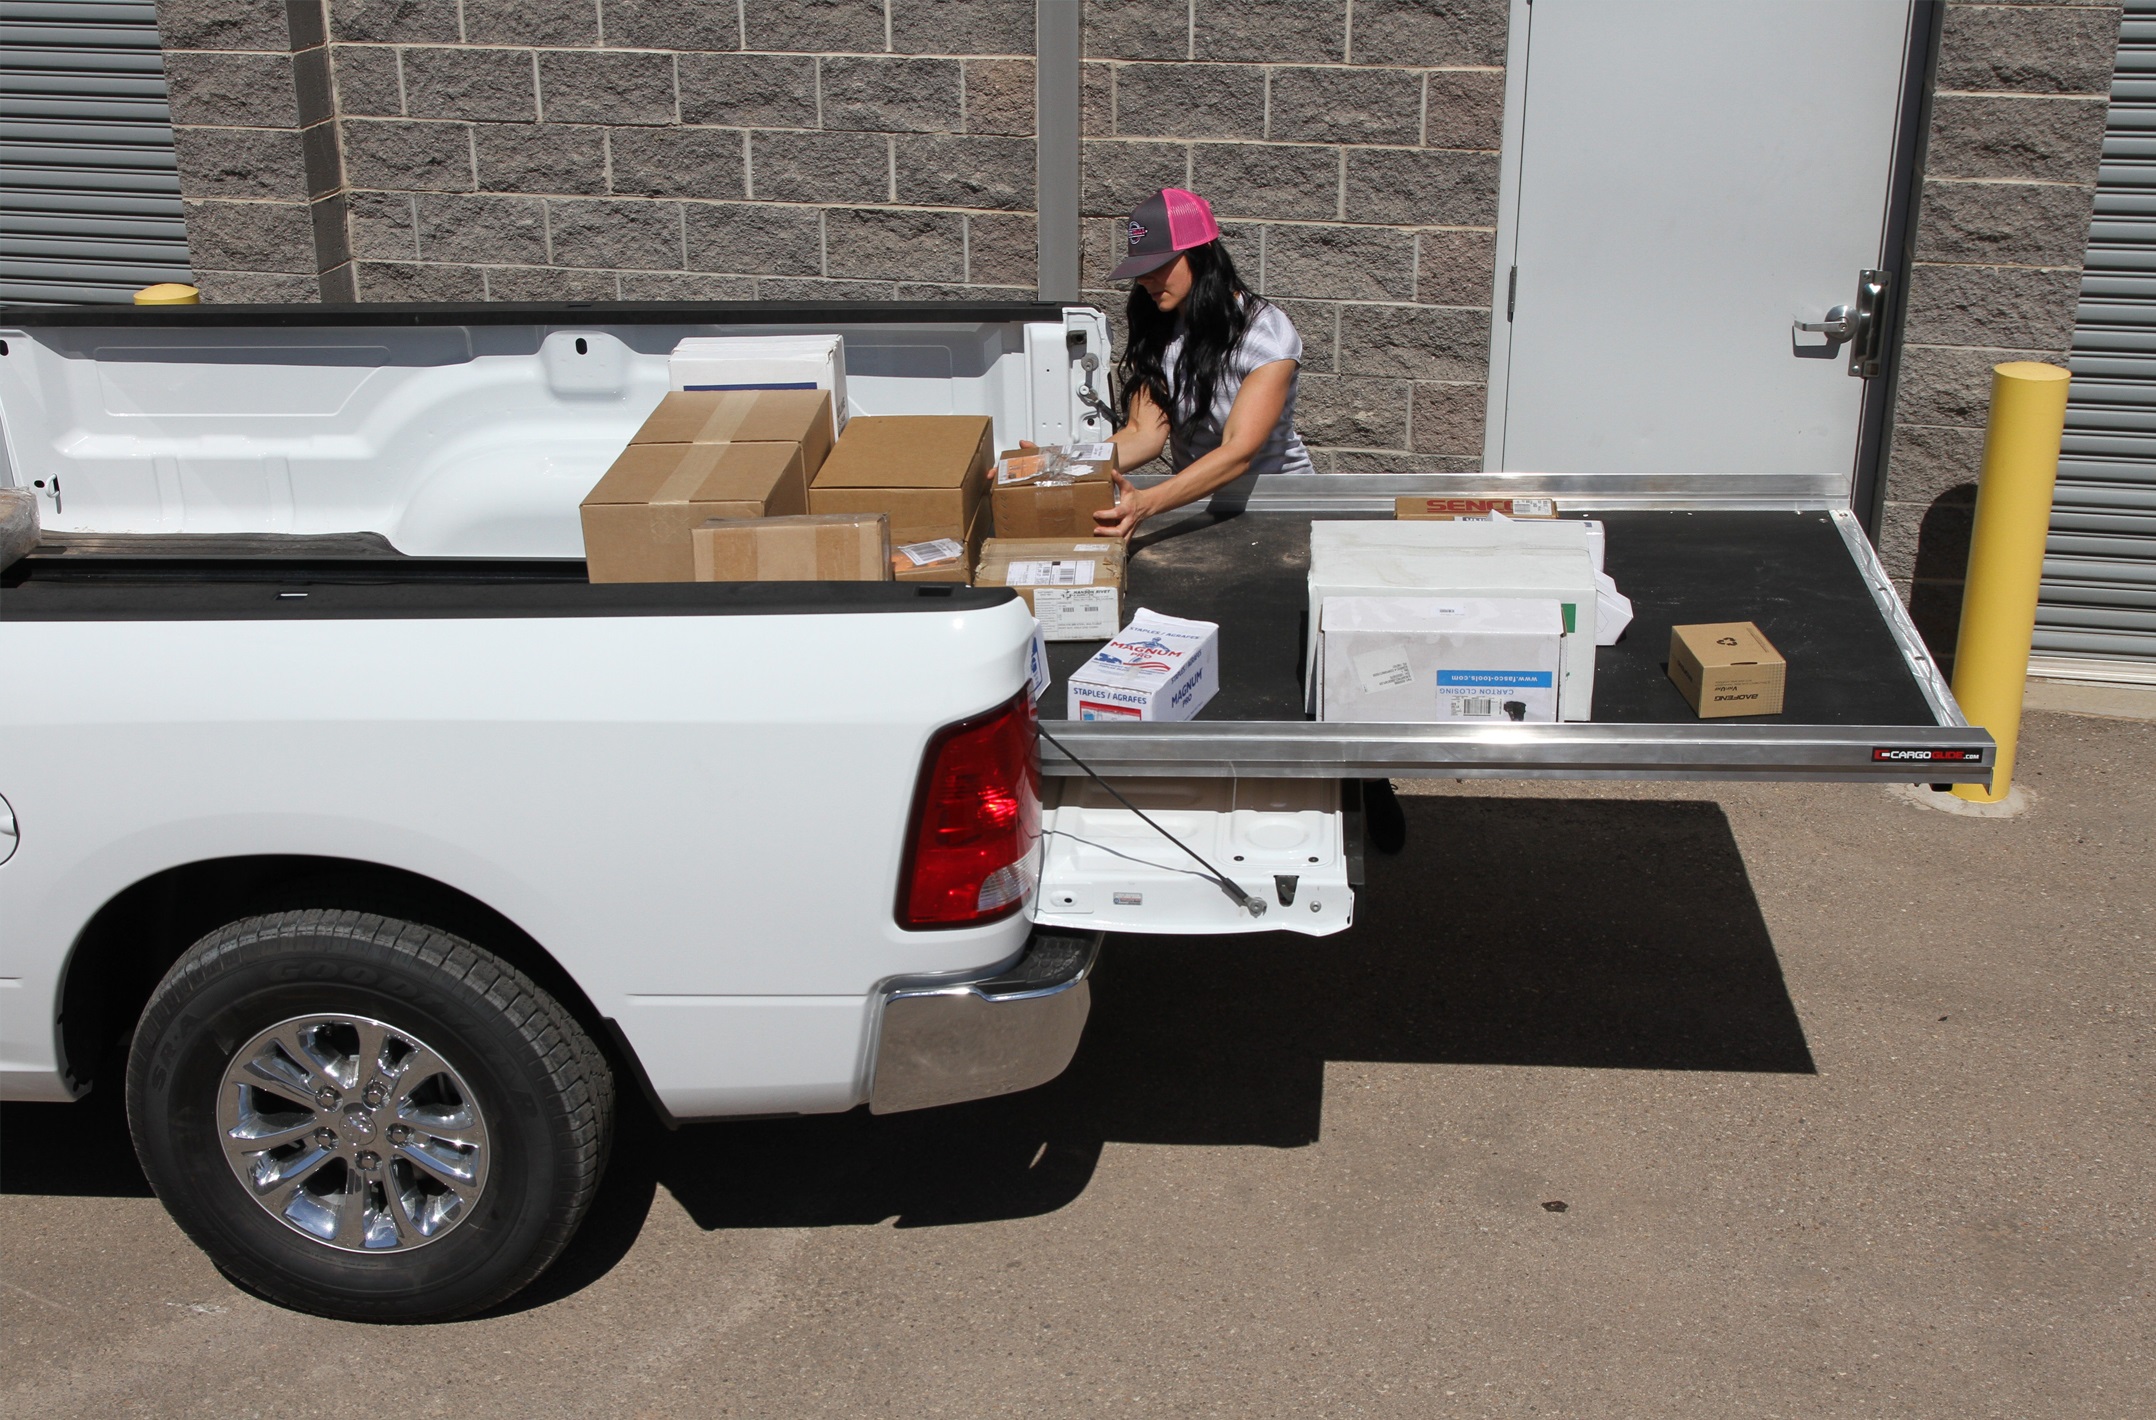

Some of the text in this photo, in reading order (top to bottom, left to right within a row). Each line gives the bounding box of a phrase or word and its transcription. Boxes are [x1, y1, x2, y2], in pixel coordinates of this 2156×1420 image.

[1427, 500, 1513, 511] SENC
[1129, 626, 1161, 636] STAPLES
[1166, 632, 1201, 640] AGRAFES
[1110, 641, 1183, 658] MAGNUM
[1451, 675, 1538, 683] www.fasco-tools.com
[1171, 668, 1203, 708] MAGNUM
[1073, 687, 1106, 699] STAPLES
[1112, 693, 1147, 705] AGRAFES
[1182, 693, 1193, 708] PRO
[1713, 693, 1759, 702] BAOFENG
